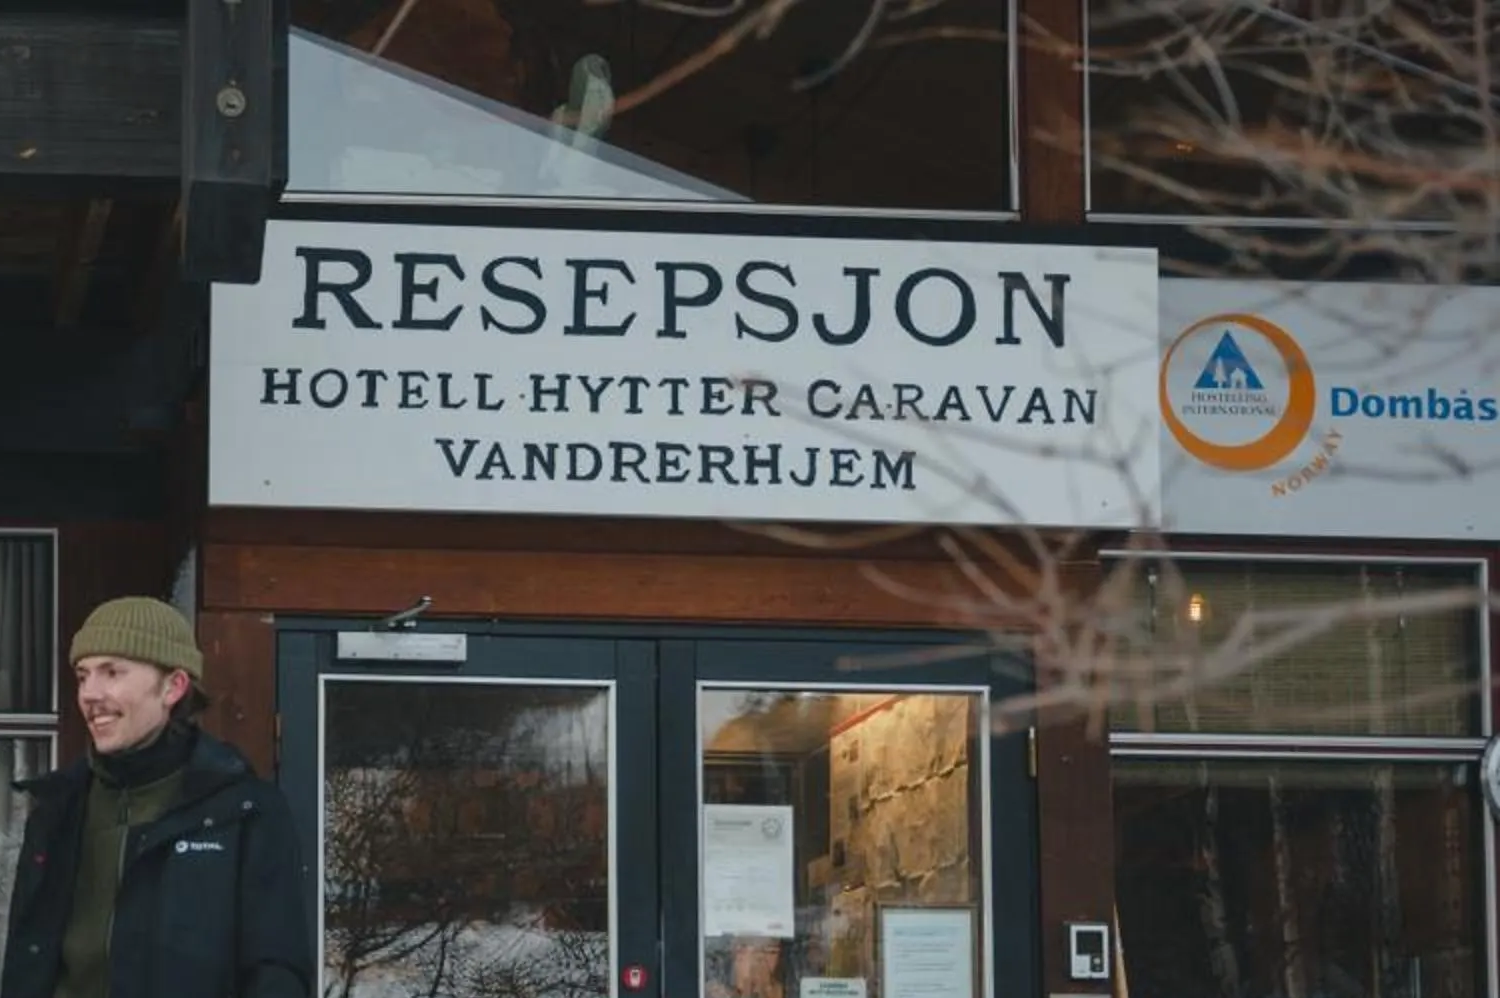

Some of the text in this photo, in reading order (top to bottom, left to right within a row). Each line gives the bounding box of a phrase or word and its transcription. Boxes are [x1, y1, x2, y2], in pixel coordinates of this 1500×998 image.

[291, 245, 1071, 348] RESEPSJON
[260, 366, 1099, 426] HOTELL HYTTER CARAVAN
[1182, 404, 1275, 417] INTERNATIONAL
[1331, 386, 1499, 421] Dombås
[434, 438, 918, 491] VANDRERHJEM
[1271, 427, 1343, 497] NORWAY
